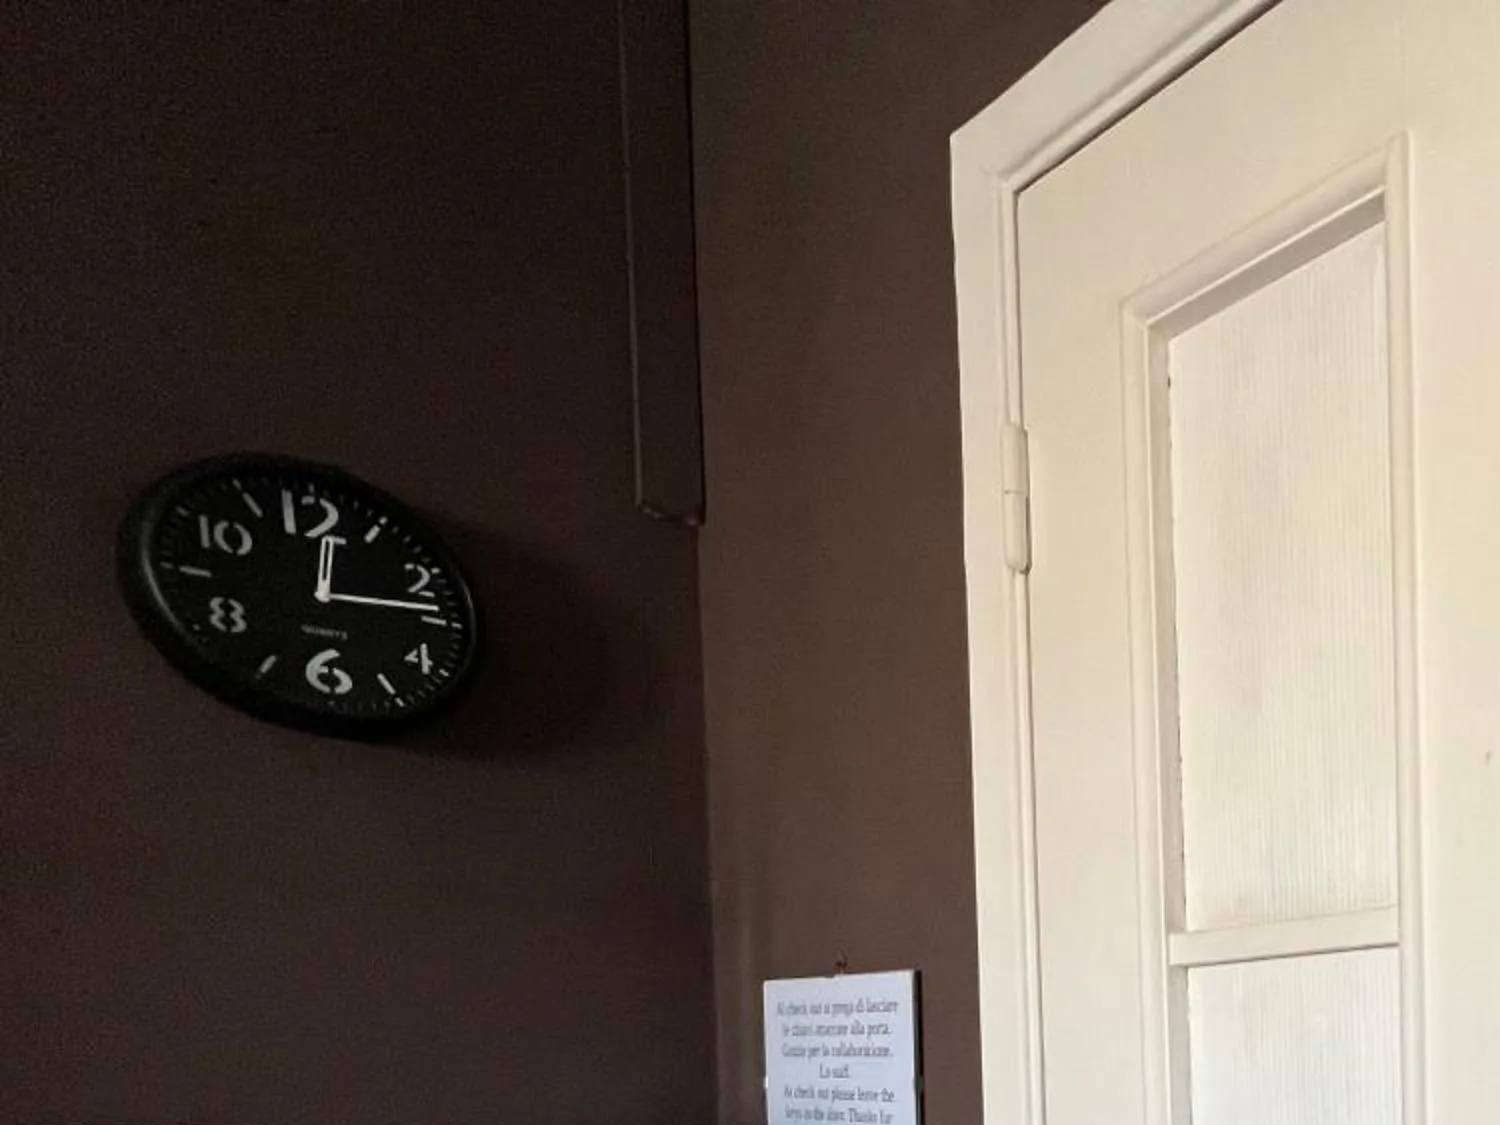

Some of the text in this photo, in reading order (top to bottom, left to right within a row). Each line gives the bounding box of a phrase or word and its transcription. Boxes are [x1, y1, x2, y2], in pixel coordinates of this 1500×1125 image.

[200, 513, 253, 556] 10
[404, 563, 435, 598] 2
[209, 596, 247, 633] 8
[305, 648, 353, 695] 6
[404, 643, 434, 675] 4
